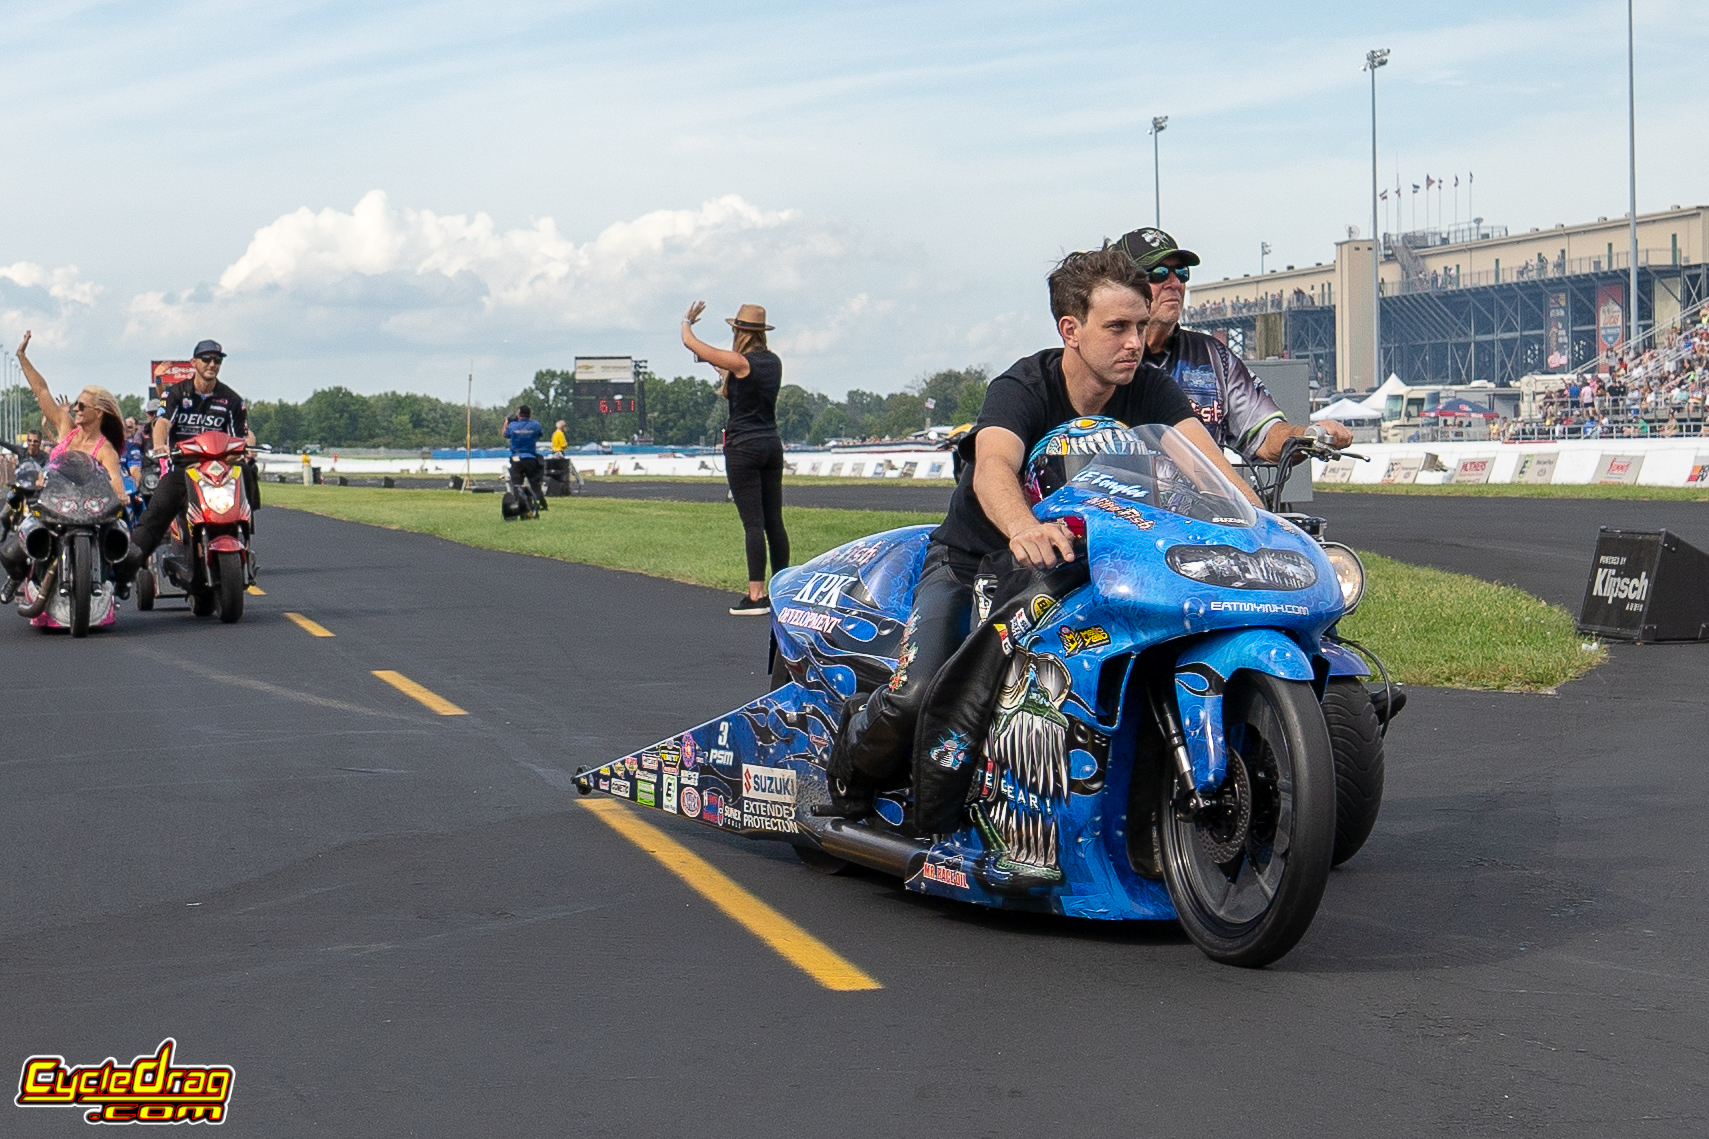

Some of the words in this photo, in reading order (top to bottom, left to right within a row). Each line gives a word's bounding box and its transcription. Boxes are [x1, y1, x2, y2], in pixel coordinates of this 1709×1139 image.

[178, 413, 225, 428] DENSO
[791, 572, 859, 609] KPK
[1592, 567, 1649, 605] Klipsch
[777, 606, 843, 634] DEVELOPMENT
[718, 721, 729, 746] 3
[753, 774, 796, 797] SUZUKI
[743, 799, 796, 820] EXTENDED
[743, 813, 800, 835] PROTECTION
